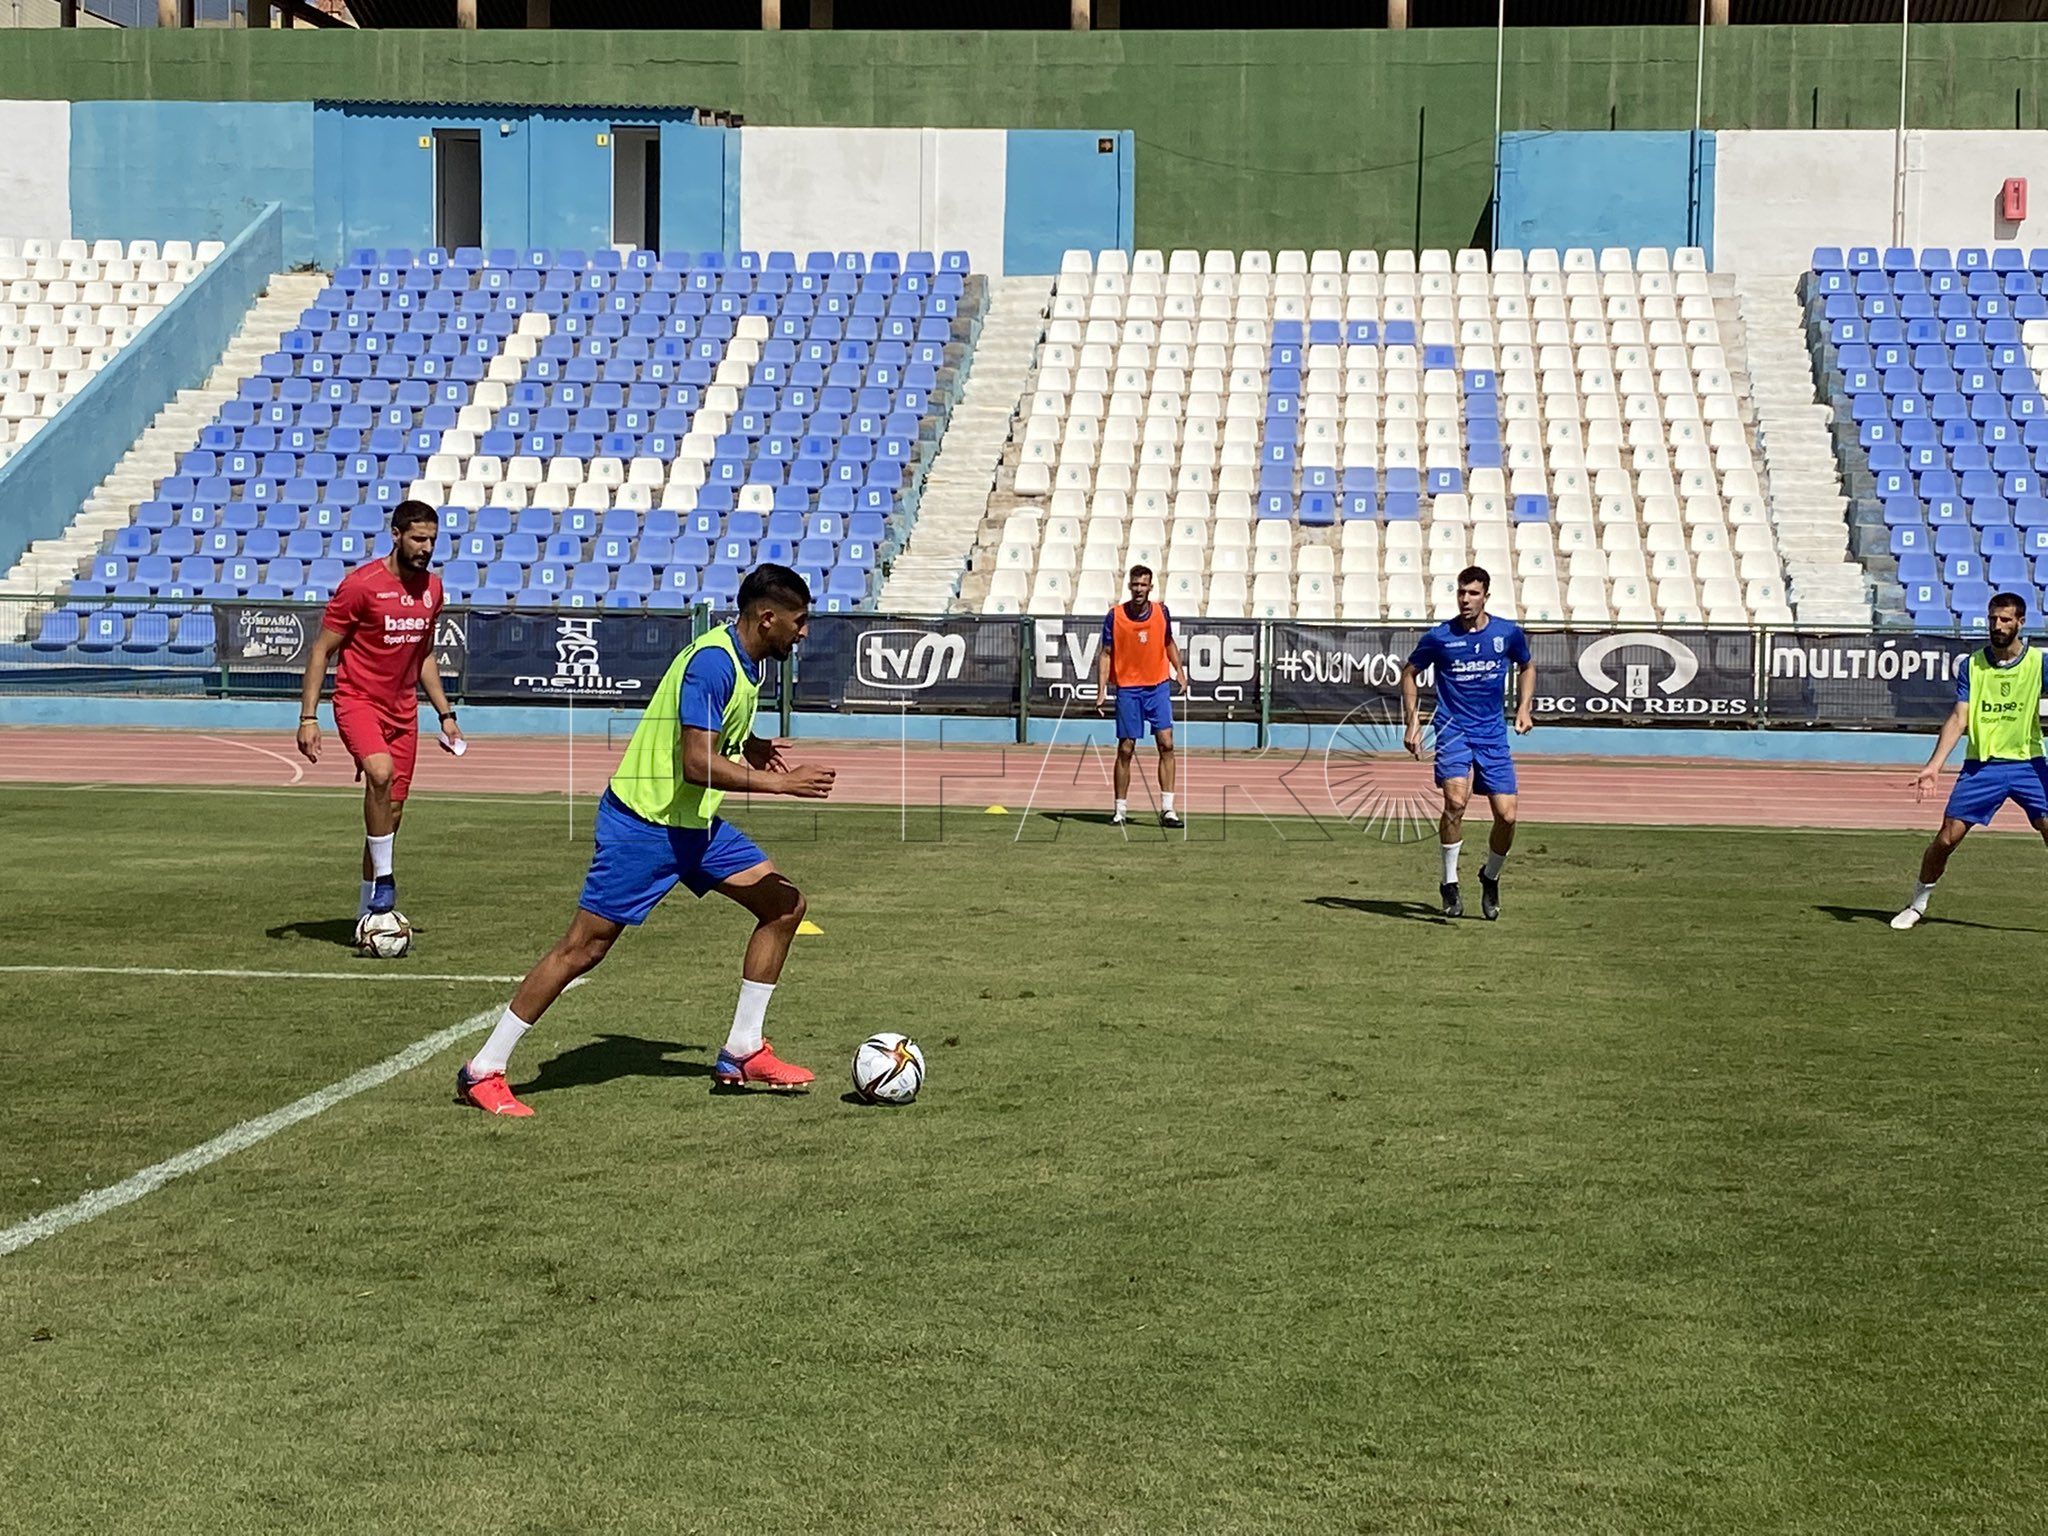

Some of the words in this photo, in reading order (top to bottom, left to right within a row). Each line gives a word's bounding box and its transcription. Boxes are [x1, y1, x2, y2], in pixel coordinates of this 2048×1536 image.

[1034, 618, 1255, 682] Evtos
[1772, 639, 1970, 681] MULTIÓPTIC
[1585, 697, 1634, 714] ON
[1643, 698, 1747, 714] REDES
